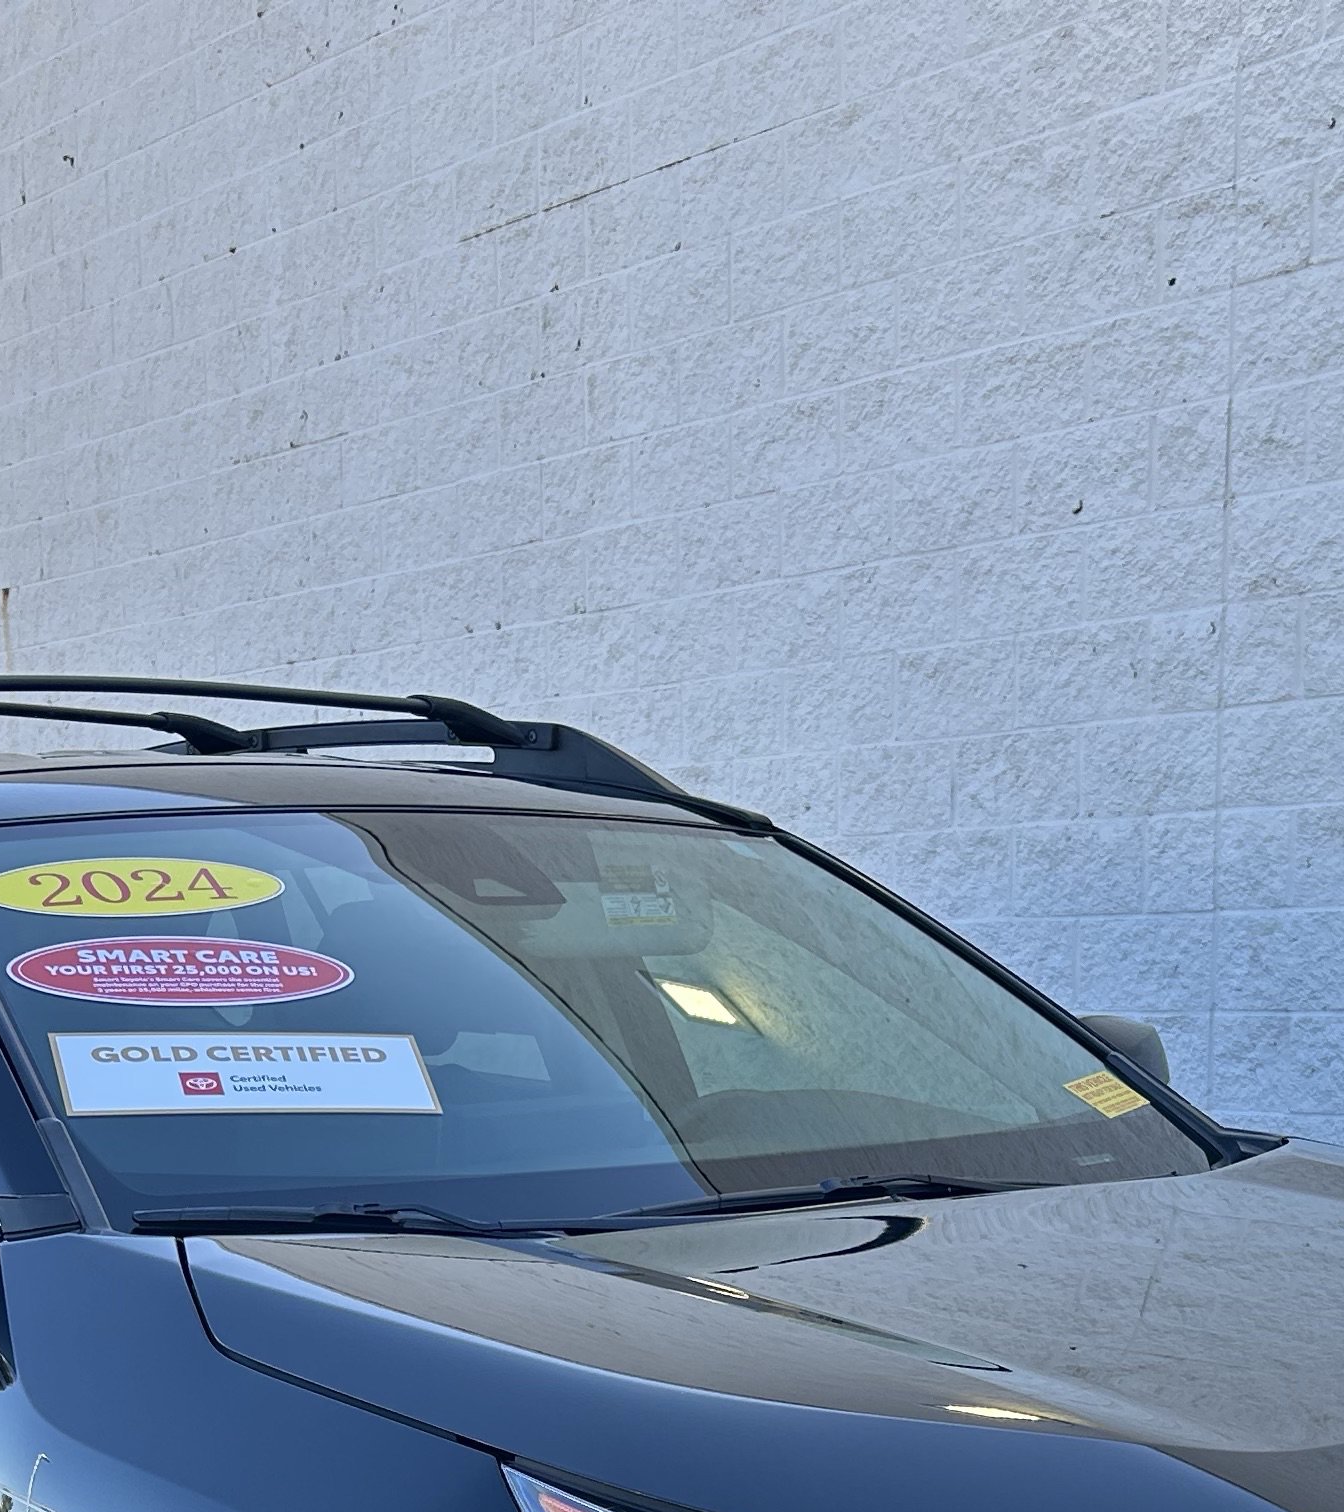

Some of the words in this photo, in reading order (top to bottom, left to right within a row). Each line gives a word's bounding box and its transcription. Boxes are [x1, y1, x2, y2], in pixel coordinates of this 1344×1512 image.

[28, 868, 238, 907] 2024
[77, 949, 193, 964] SMART
[195, 949, 280, 964] CARE
[44, 964, 108, 976] YOUR
[110, 964, 168, 976] FIRST
[173, 965, 240, 977] 25,000
[249, 965, 280, 976] ON
[285, 965, 318, 977] US!
[90, 1046, 198, 1063] GOLD
[206, 1045, 387, 1063] CERTIFIED
[229, 1074, 287, 1083] Certified
[232, 1083, 266, 1092] Used
[268, 1083, 322, 1092] Vehicles
